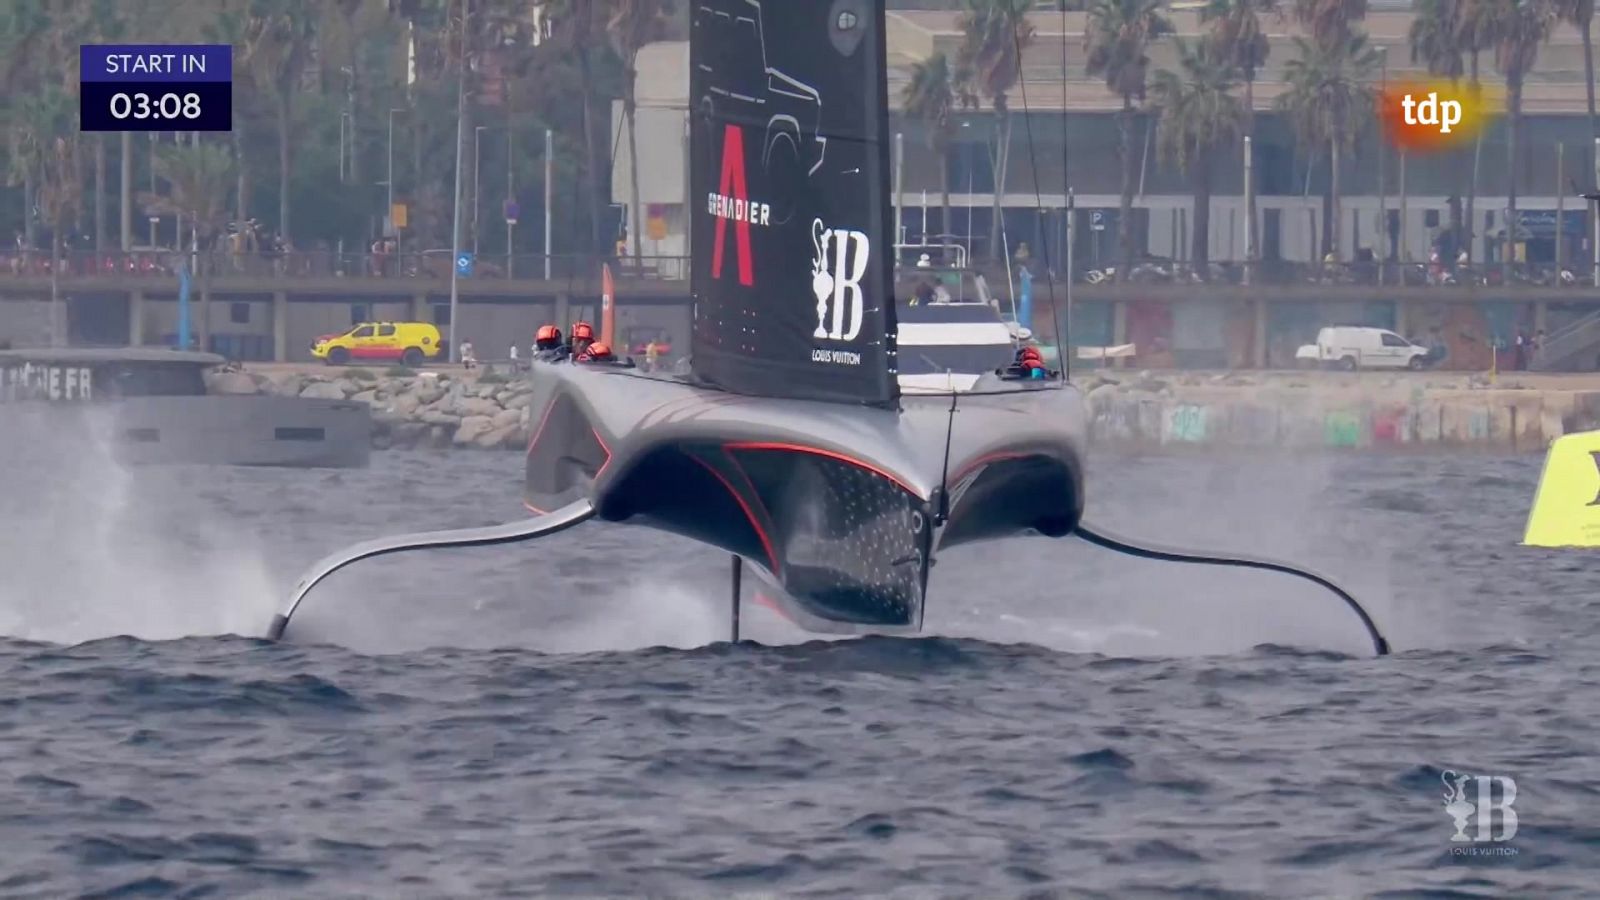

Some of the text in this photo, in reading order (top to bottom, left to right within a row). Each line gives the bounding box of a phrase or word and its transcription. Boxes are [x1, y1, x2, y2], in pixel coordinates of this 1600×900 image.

[708, 192, 770, 226] GRENADIER
[812, 349, 861, 365] LOUIS VUITTON
